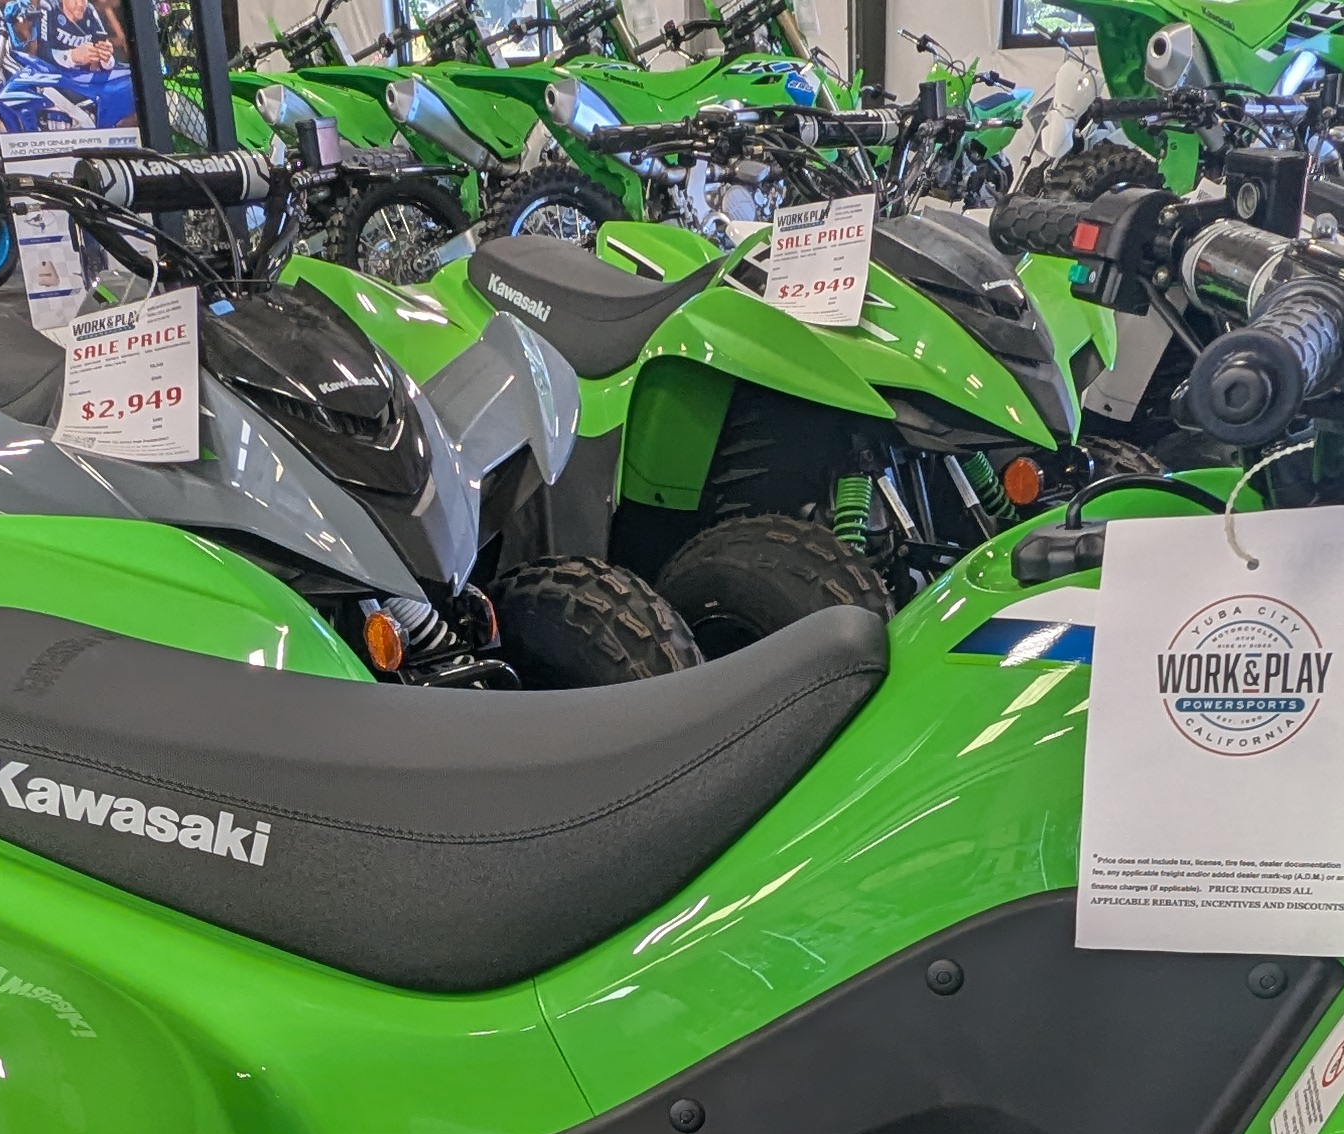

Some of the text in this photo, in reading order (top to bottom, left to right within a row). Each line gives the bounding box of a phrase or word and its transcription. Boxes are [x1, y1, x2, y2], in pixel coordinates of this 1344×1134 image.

[8, 141, 29, 149] SHOP
[129, 154, 236, 177] Kawasaki
[776, 233, 812, 251] SALE
[817, 224, 865, 243] PRICE
[487, 273, 552, 323] Kawasaki
[778, 276, 855, 299] $2,949
[73, 324, 188, 362] SALE PRICE
[81, 386, 183, 421] $2,949
[1190, 606, 1301, 636] YUBA CITY
[1211, 626, 1279, 643] MOTORCYCLES
[1182, 700, 1297, 710] POWERSPORTS
[1185, 717, 1295, 747] CALIFORNIA
[1121, 869, 1159, 877] applicable
[1160, 870, 1185, 878] freight
[1261, 872, 1293, 880] mark-up
[1284, 860, 1341, 869] documentation
[1119, 884, 1148, 892] charges
[1208, 885, 1239, 893] PRICE
[1241, 886, 1291, 895] INCLUDES
[1293, 887, 1313, 895] ALL
[1091, 897, 1150, 906] APPLICABLE
[1152, 898, 1198, 908] REBATES,
[1200, 900, 1261, 909] INCENTIVES
[1262, 901, 1285, 909] AND
